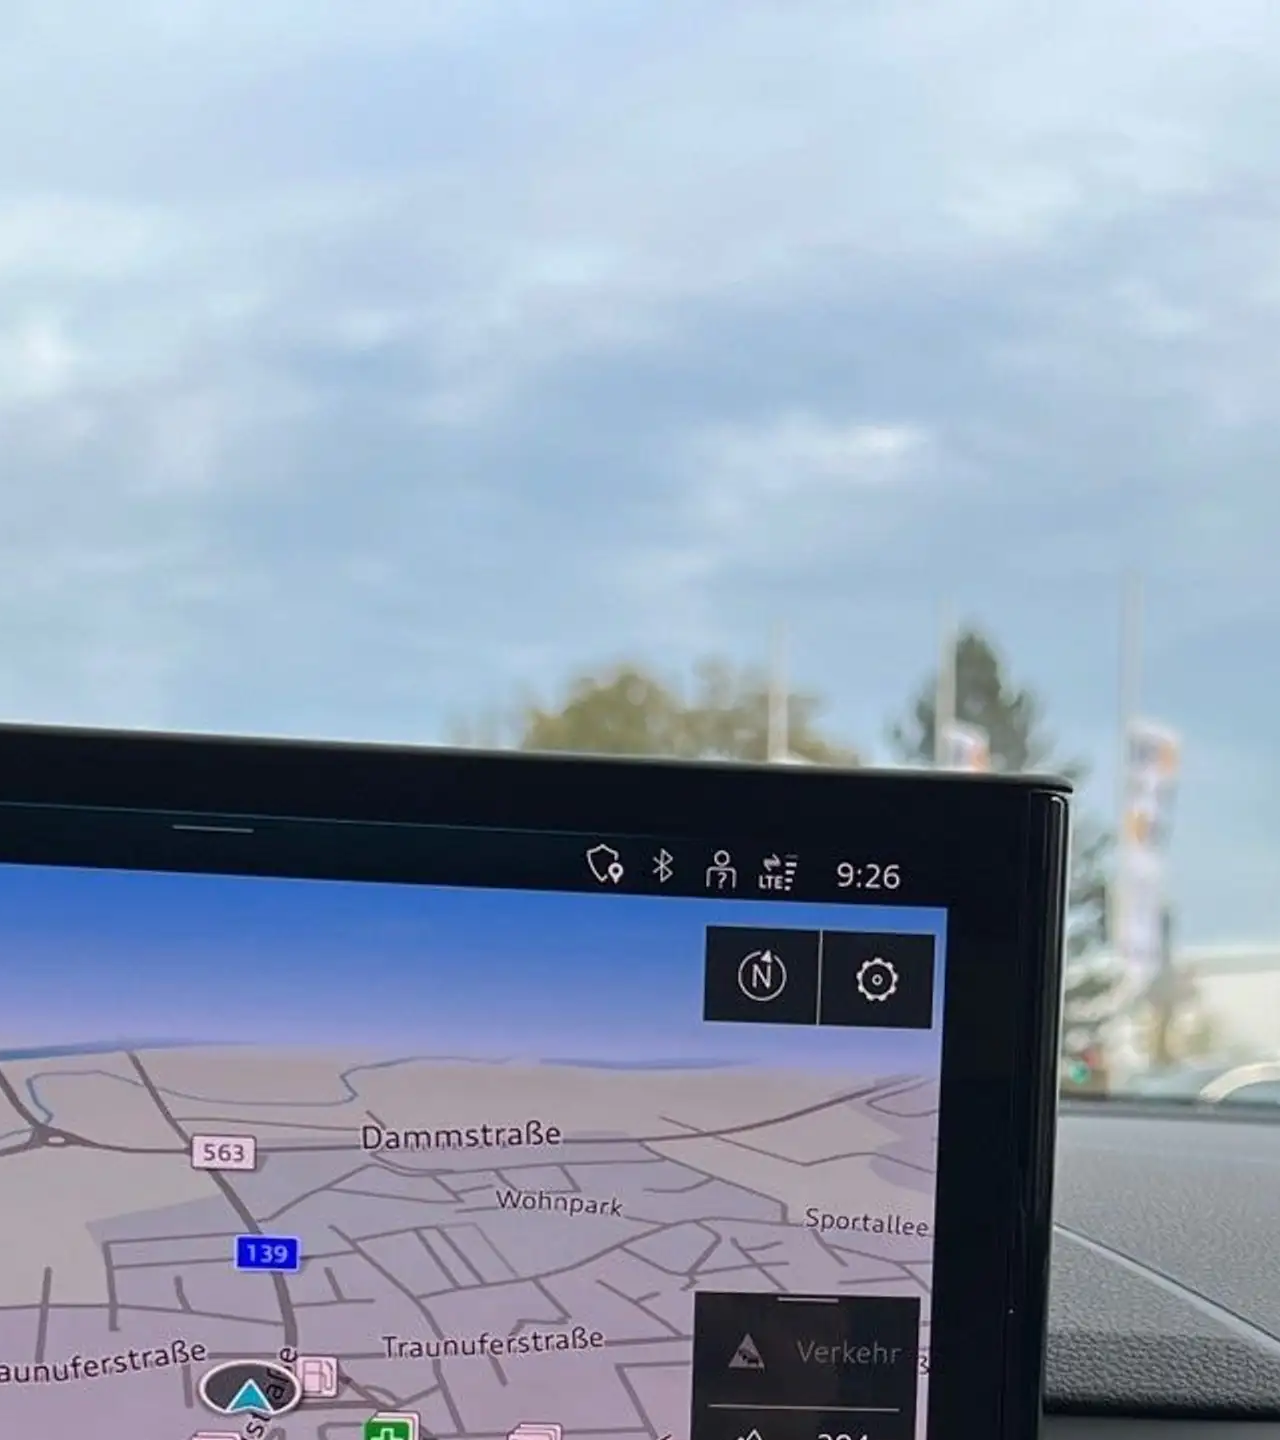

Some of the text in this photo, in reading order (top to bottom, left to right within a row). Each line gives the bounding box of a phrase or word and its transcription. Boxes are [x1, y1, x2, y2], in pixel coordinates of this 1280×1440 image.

[758, 874, 784, 890] LTE
[836, 862, 901, 890] 9:26
[360, 1122, 562, 1150] Dammstraße
[203, 1143, 245, 1163] 563
[496, 1189, 623, 1219] Wohnpark
[804, 1206, 929, 1238] Sportallee
[246, 1244, 289, 1264] 139
[382, 1326, 605, 1361] Traunuferstraße
[797, 1340, 903, 1364] Verkehr
